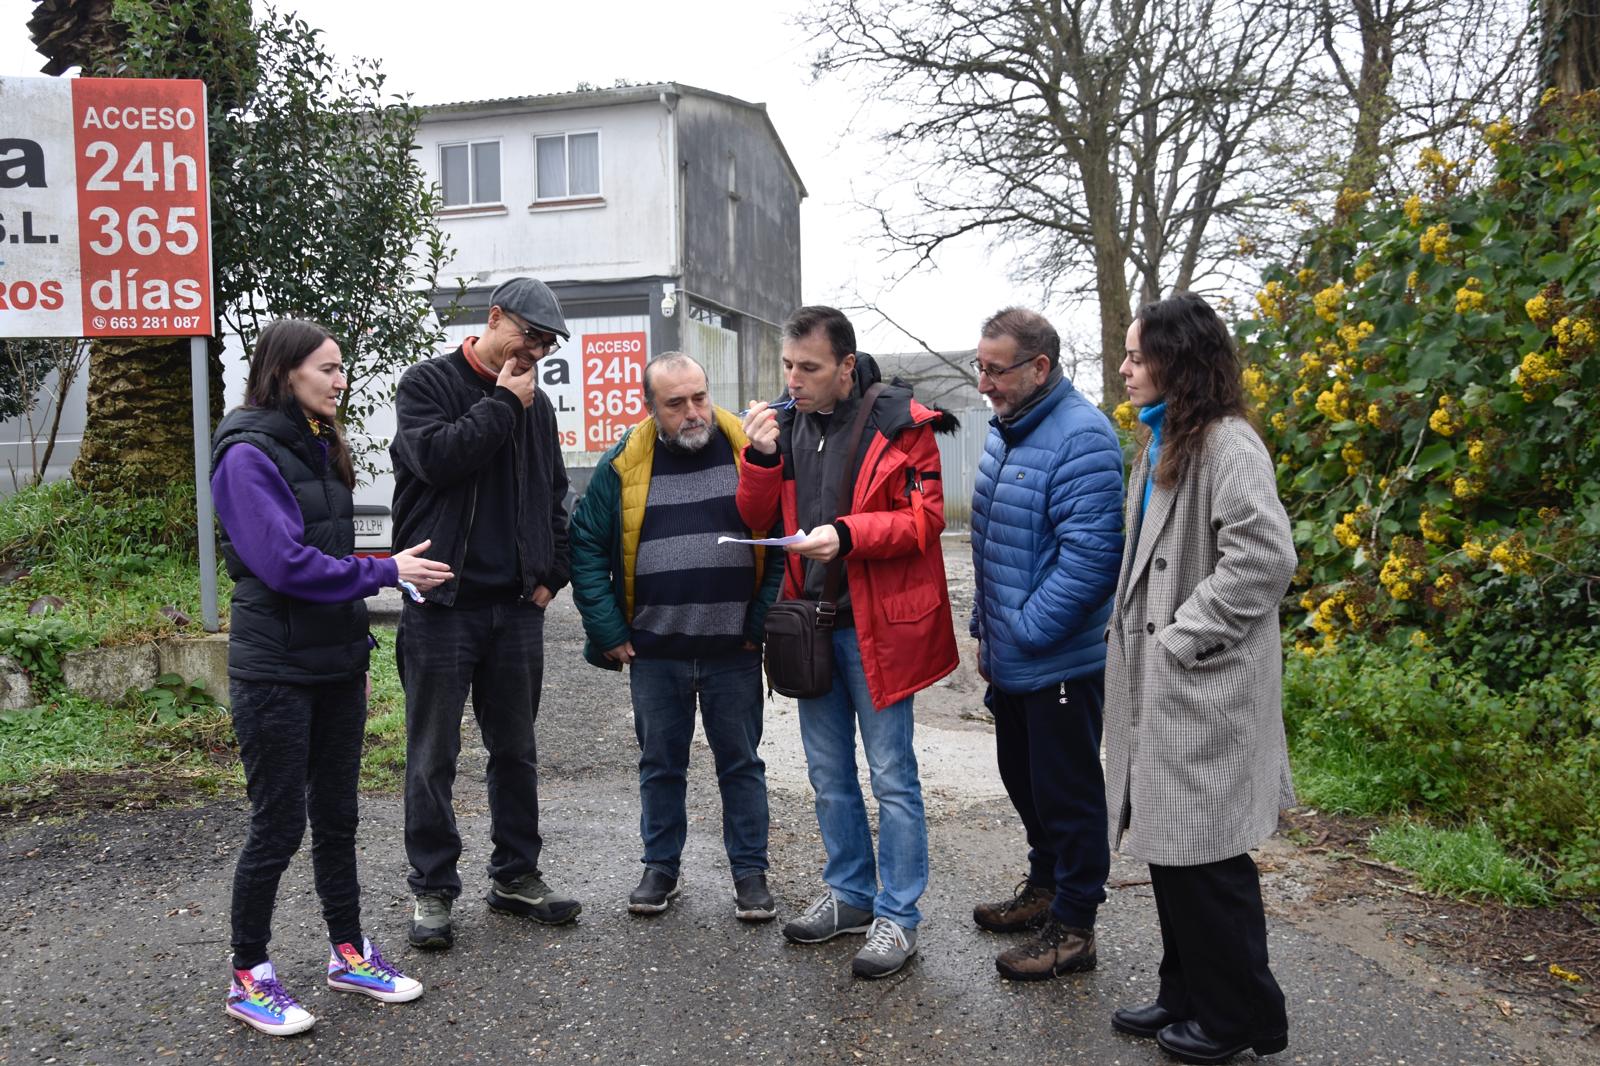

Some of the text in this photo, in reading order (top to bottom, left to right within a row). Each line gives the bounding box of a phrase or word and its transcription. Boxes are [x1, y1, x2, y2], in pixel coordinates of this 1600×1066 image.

[83, 107, 195, 130] ACCESO
[85, 141, 197, 191] 24h
[0, 212, 59, 244] .L.
[89, 206, 199, 256] 365
[90, 269, 202, 310] días
[110, 316, 200, 329] 663 281 087
[586, 339, 641, 354] ACCESO
[587, 357, 642, 385] 24h
[588, 389, 642, 417] 365
